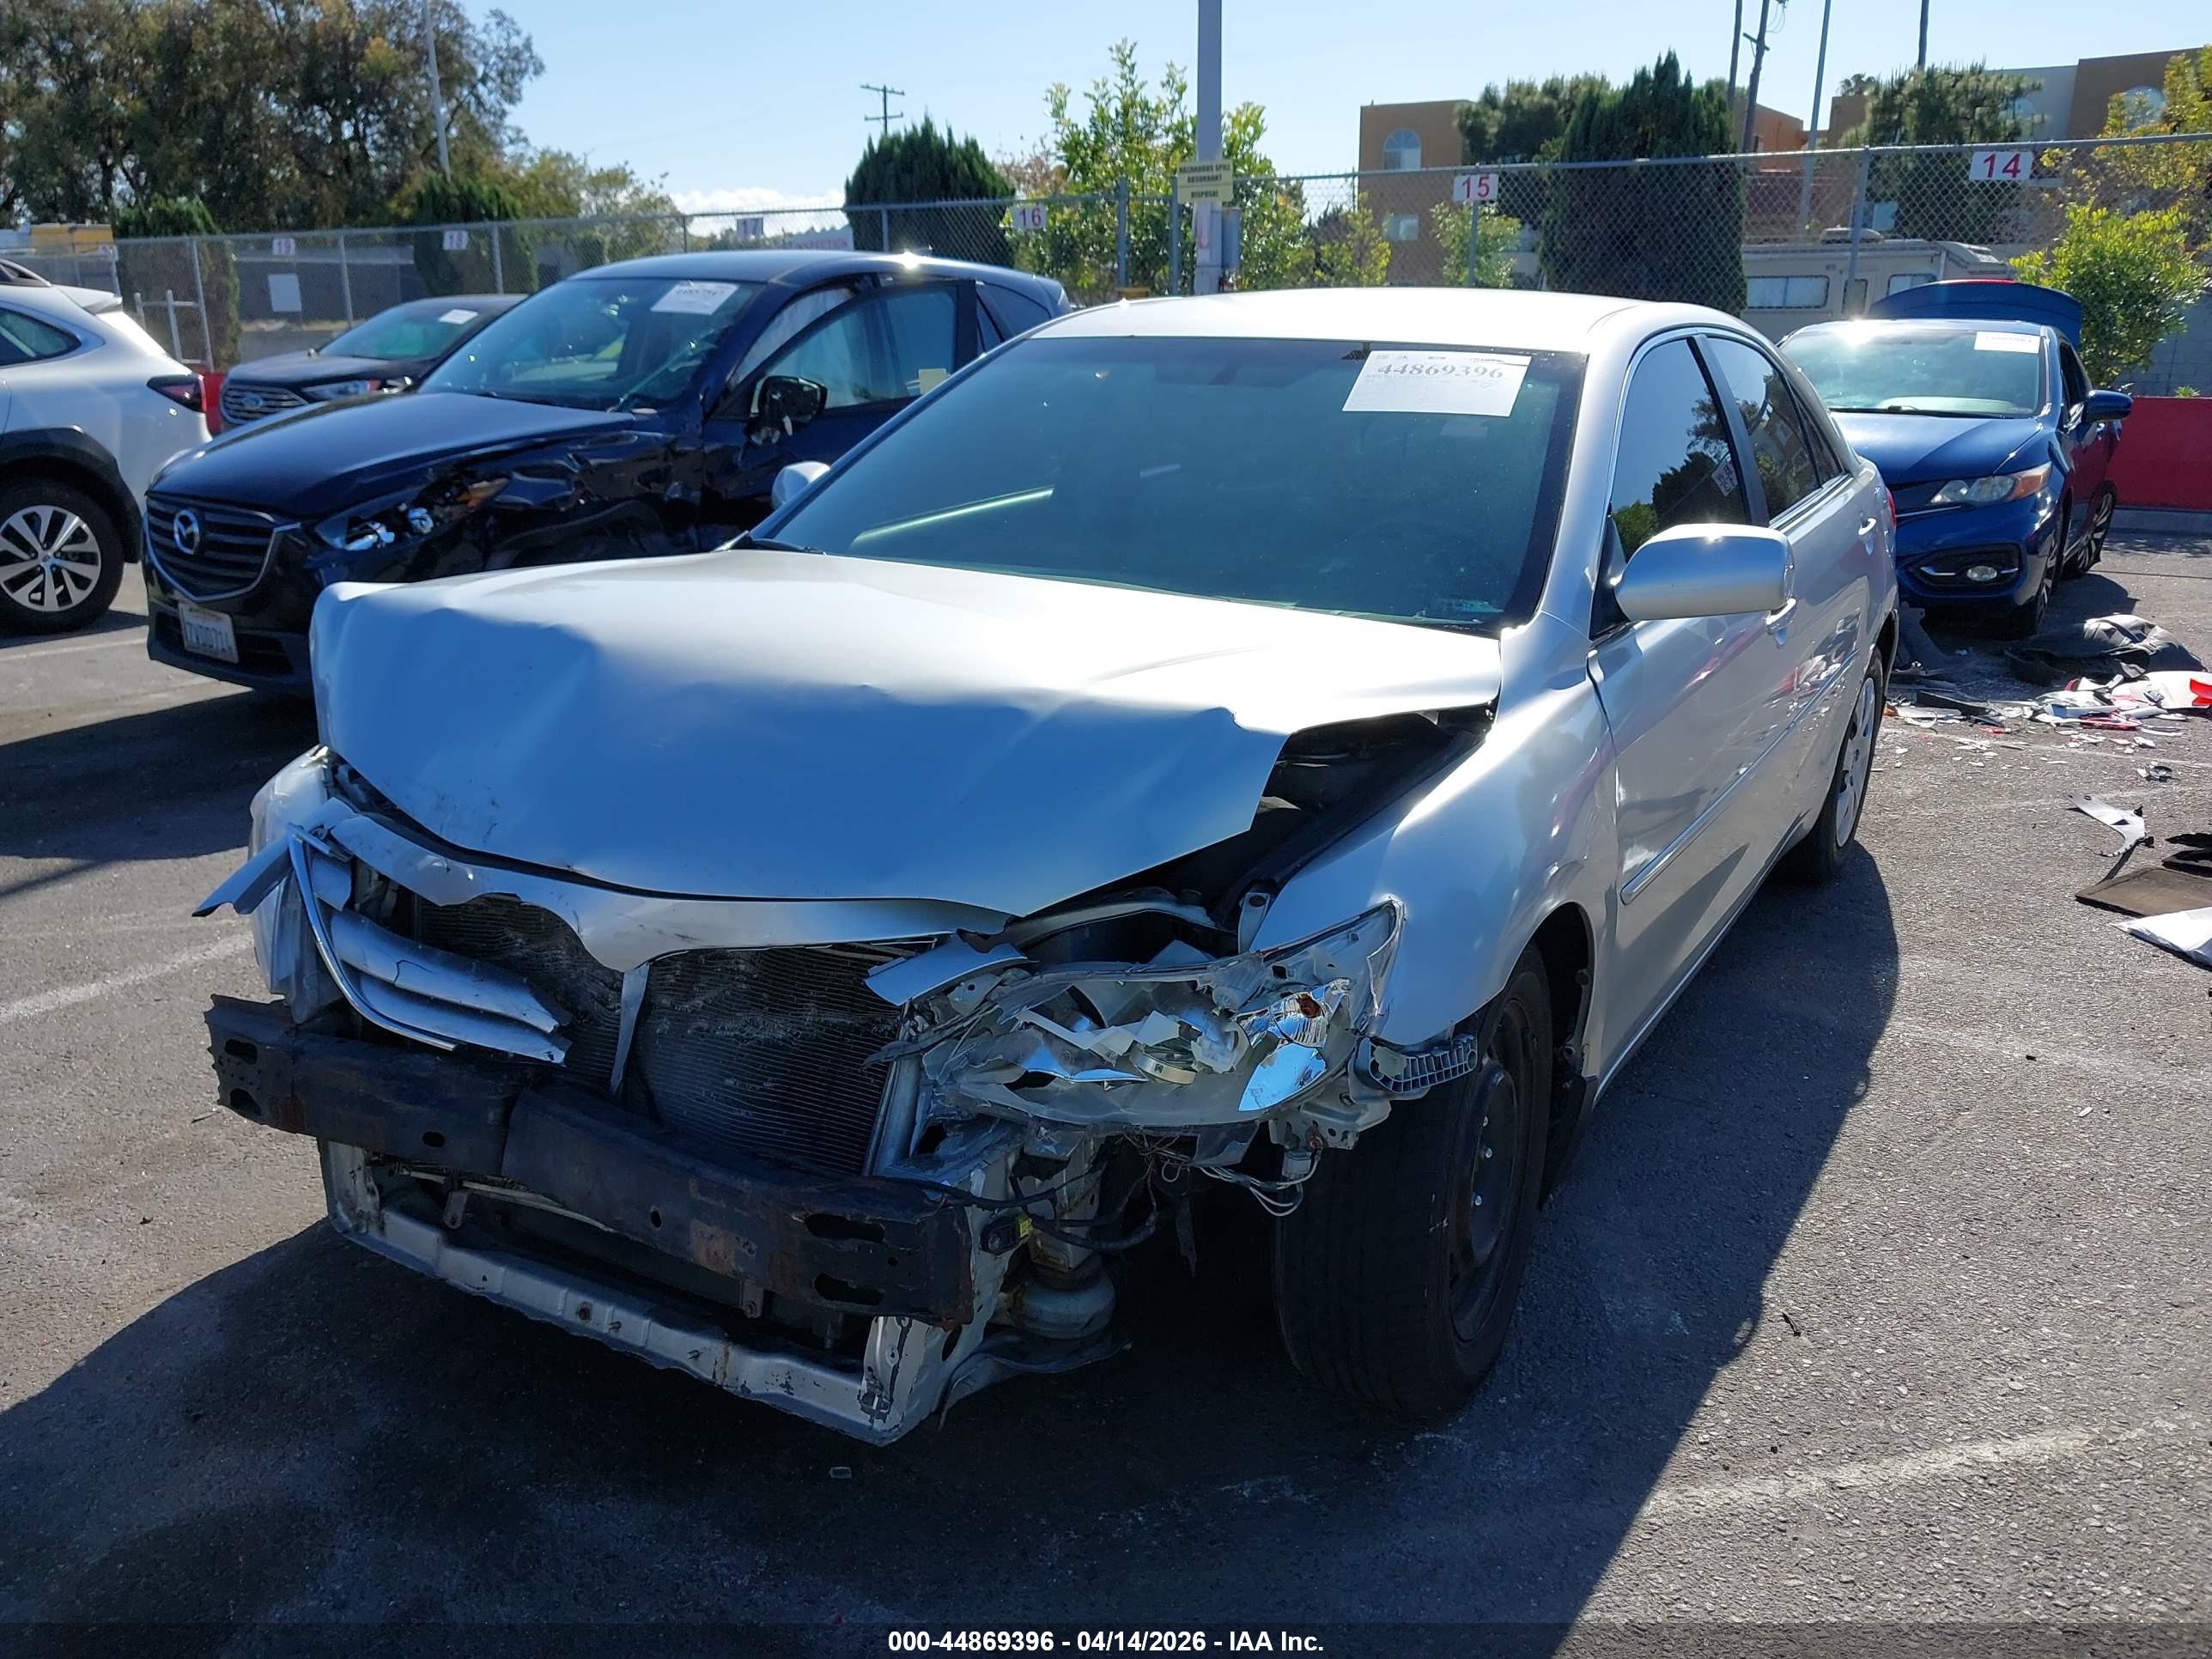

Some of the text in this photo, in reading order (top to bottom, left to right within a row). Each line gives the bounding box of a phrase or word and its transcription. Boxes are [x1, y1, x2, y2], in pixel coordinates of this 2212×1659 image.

[1984, 153, 2021, 179] 14
[1462, 175, 1490, 198] 15
[742, 218, 760, 236] 17
[1019, 207, 1041, 227] 16
[1377, 363, 1504, 379] 44869396
